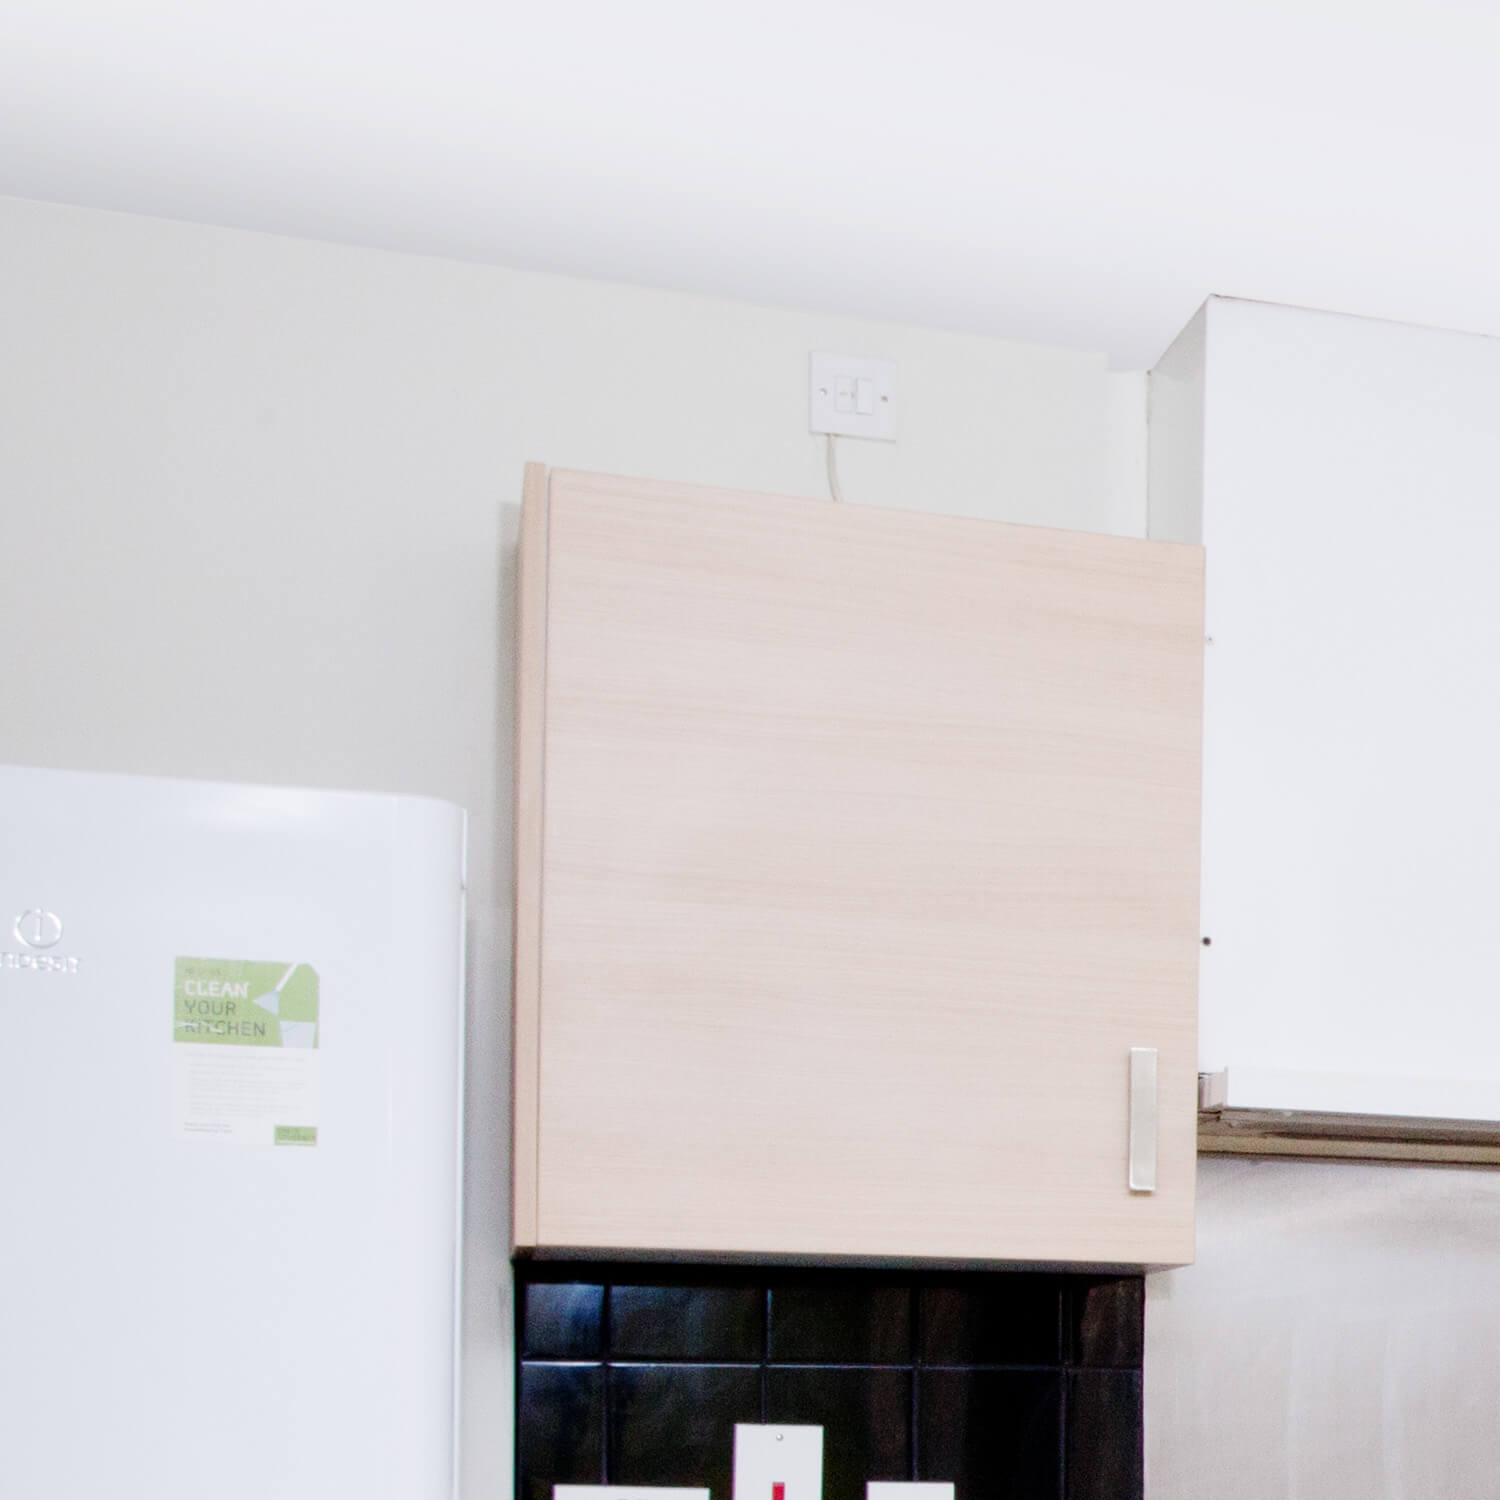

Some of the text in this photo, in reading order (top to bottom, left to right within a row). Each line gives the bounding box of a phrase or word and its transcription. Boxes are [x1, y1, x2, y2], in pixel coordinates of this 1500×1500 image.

[0, 952, 82, 973] NDESIT
[183, 980, 249, 999] CLEAN
[184, 999, 237, 1016] YOUR
[184, 1018, 266, 1037] KITCHEN
